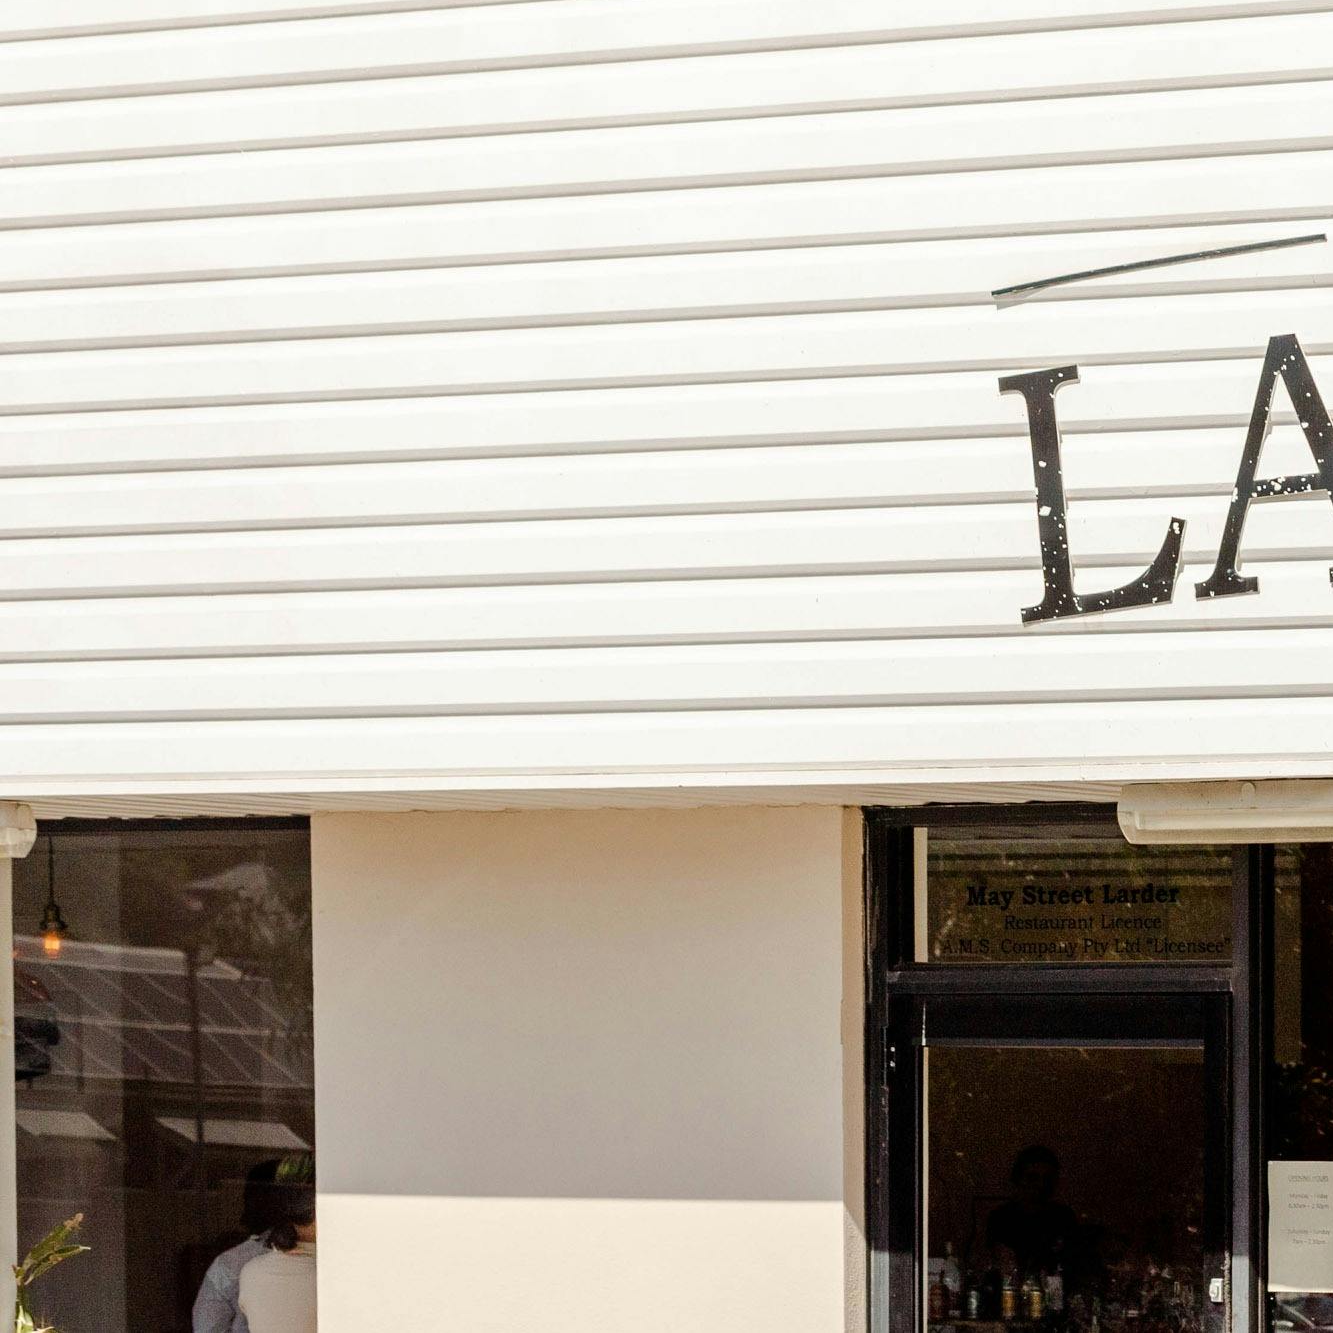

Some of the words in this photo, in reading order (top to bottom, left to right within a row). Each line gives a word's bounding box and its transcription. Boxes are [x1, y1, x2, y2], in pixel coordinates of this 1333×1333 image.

[967, 885, 1014, 910] May
[1022, 884, 1095, 906] Street
[1103, 883, 1180, 905] Larder
[1004, 914, 1094, 931] Restaurant
[1101, 914, 1162, 930] Licence
[1001, 938, 1077, 958] Company
[1084, 939, 1107, 955] Pty
[1115, 938, 1142, 953] Ltd
